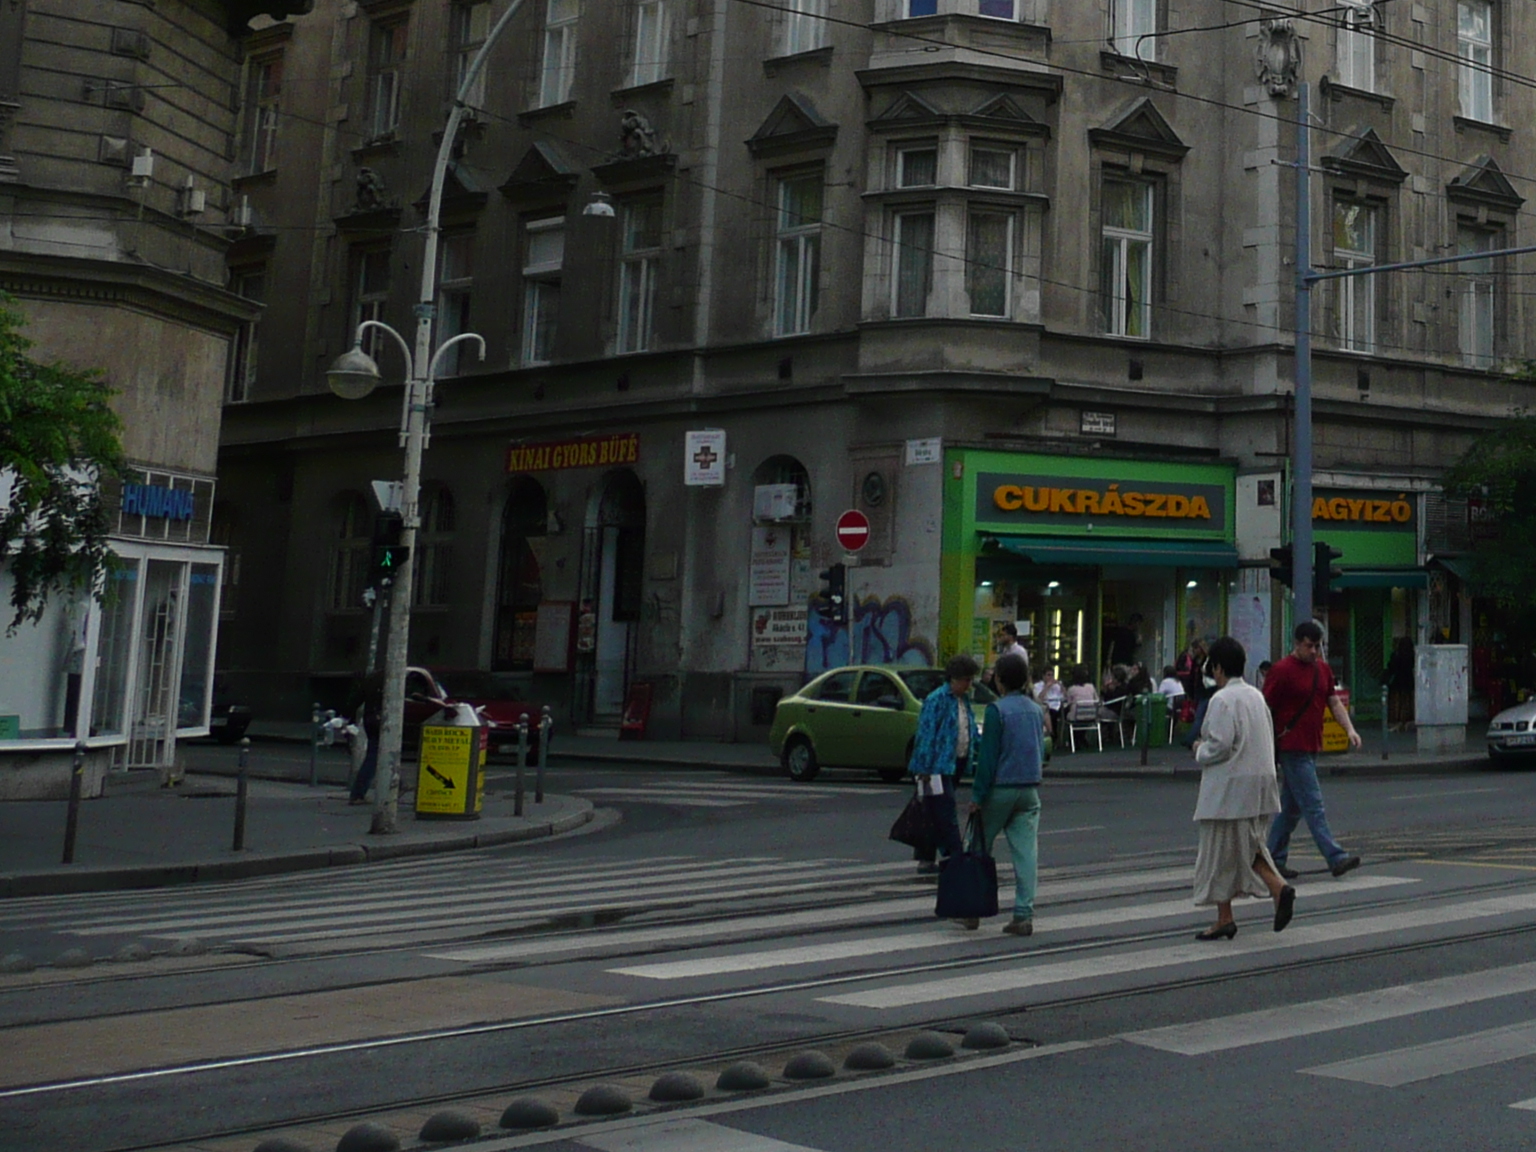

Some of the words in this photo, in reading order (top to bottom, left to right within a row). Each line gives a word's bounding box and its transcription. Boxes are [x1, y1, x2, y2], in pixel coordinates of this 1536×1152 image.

[509, 444, 551, 472] KÍNAI
[552, 441, 598, 469] GYORS
[599, 433, 638, 464] BÜFÉ
[122, 483, 194, 520] HUMANA
[993, 483, 1212, 519] CUKRÁSZDA
[1311, 492, 1412, 523] AGYIZÓ
